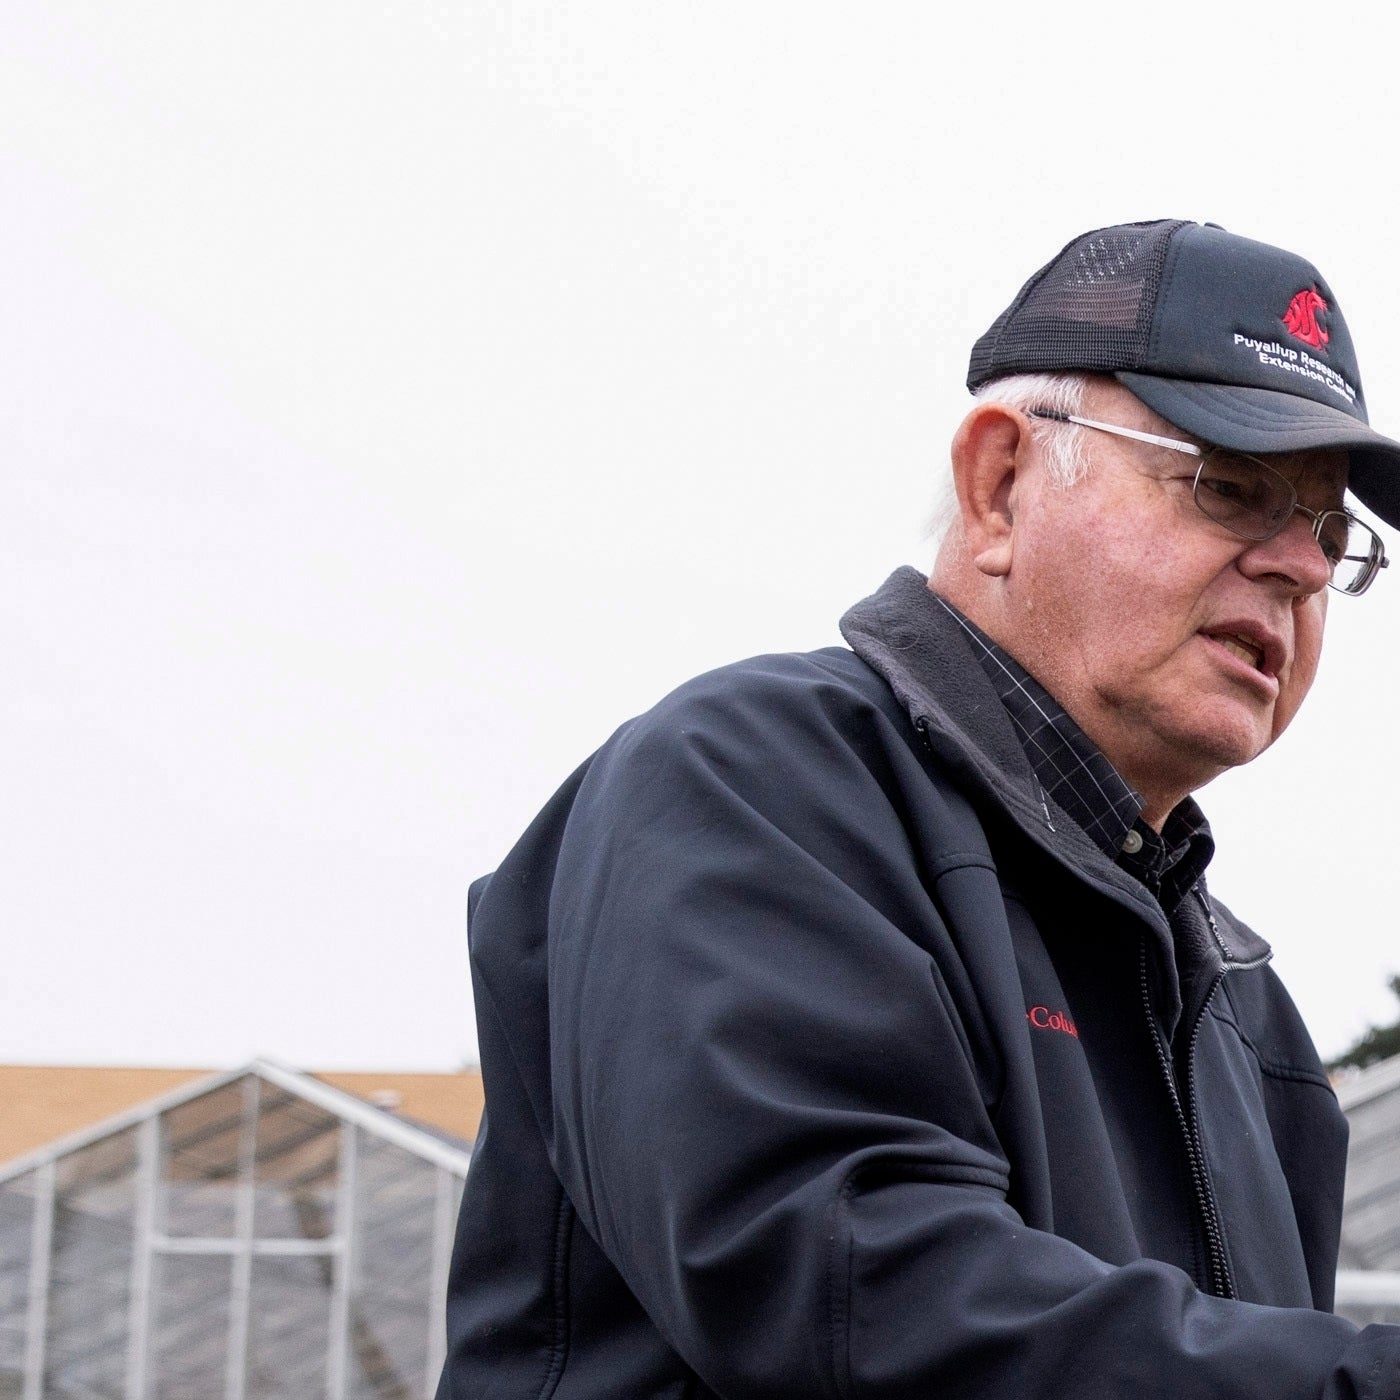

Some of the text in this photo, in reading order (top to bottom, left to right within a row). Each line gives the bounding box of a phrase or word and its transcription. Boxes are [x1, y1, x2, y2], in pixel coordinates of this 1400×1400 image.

[1234, 333, 1344, 388] Puyallup Research
[1259, 352, 1326, 384] Extension
[1213, 924, 1233, 958] Colu
